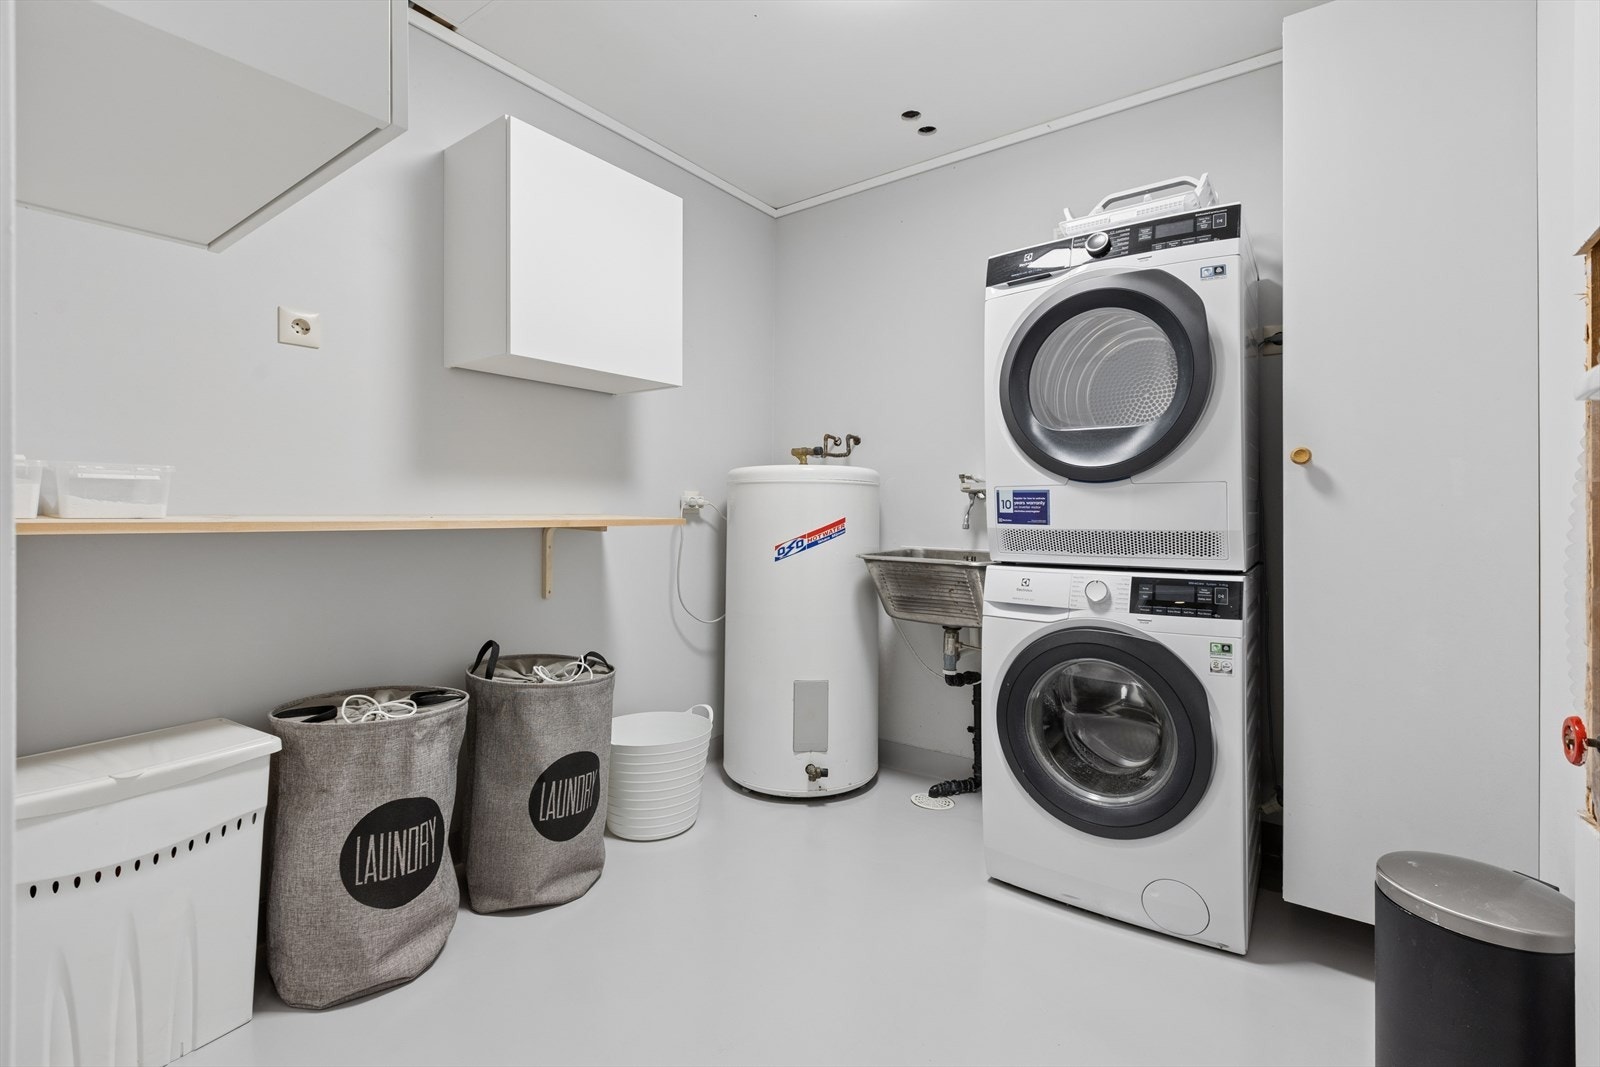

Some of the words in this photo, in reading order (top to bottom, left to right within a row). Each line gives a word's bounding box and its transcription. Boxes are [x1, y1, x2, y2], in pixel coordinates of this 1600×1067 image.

[1001, 500, 1012, 510] 10
[807, 534, 822, 544] HOT
[822, 523, 845, 537] WATER
[539, 769, 598, 822] LAUNDRY
[355, 815, 437, 886] LAUNDRY
